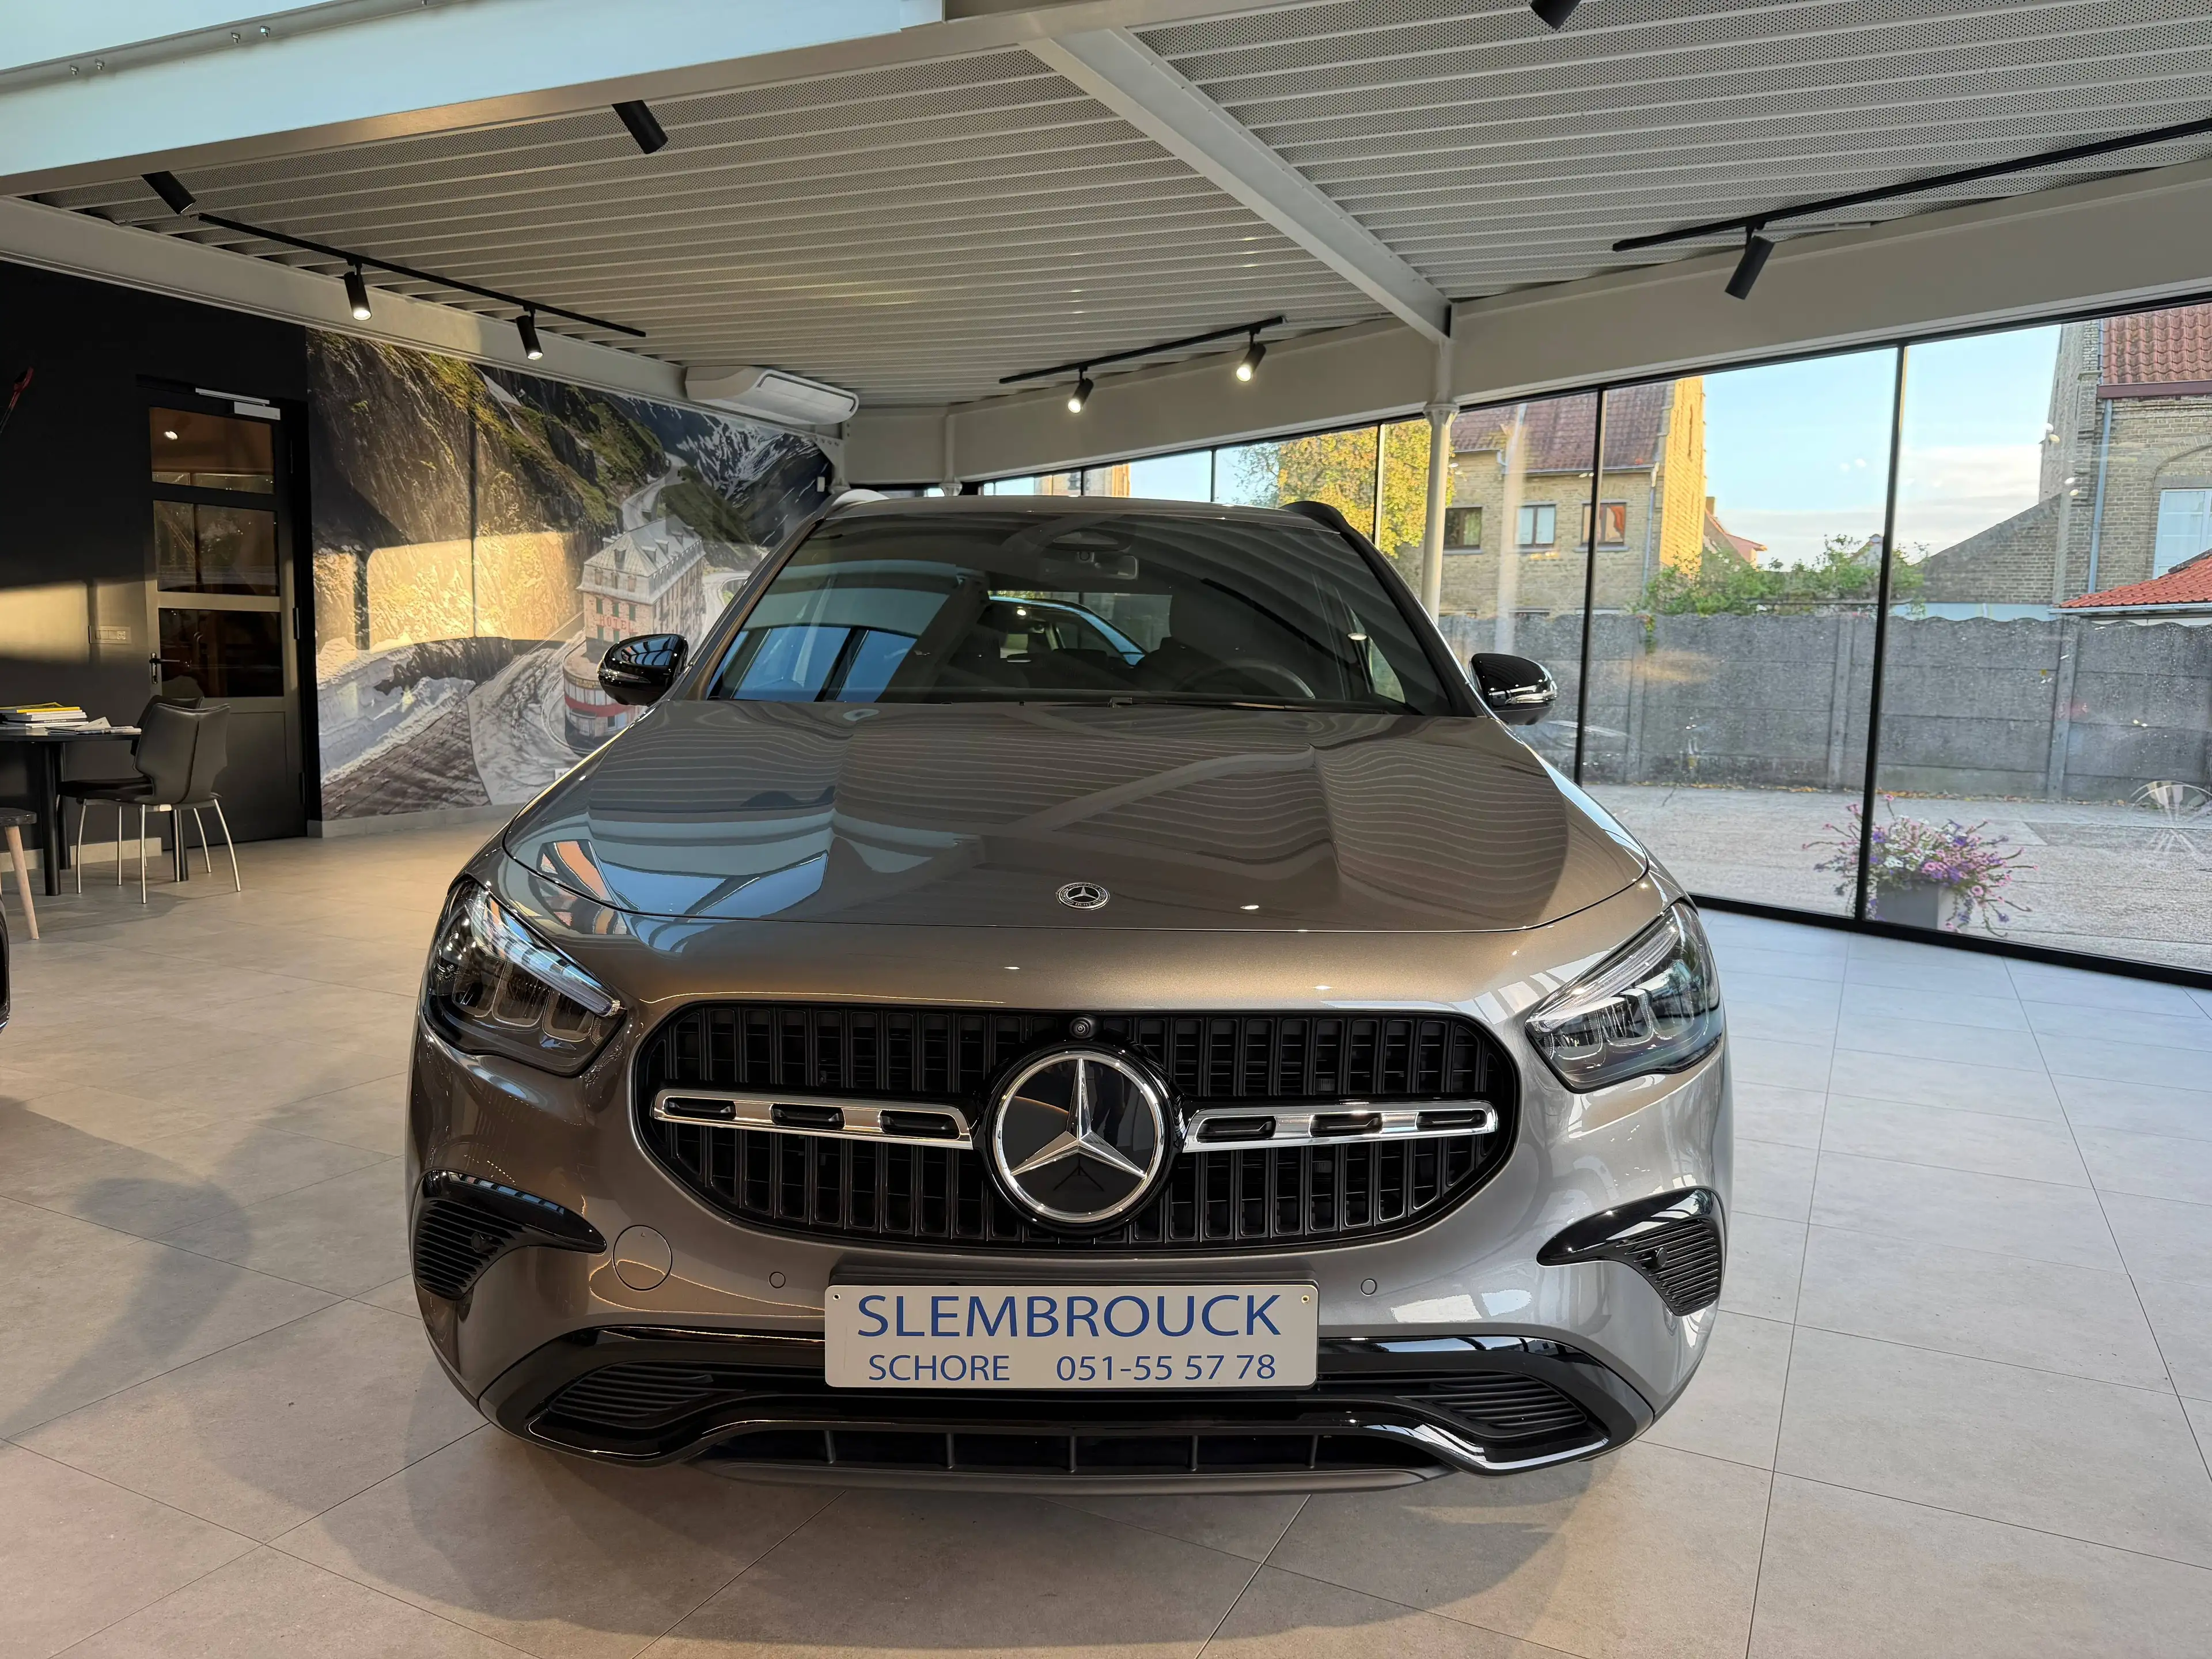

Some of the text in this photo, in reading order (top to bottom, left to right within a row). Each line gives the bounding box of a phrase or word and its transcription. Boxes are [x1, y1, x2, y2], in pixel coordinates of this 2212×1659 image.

[600, 615, 638, 633] HOTEL
[857, 1295, 1282, 1338] SLEMBROUCK
[869, 1354, 1276, 1381] SCHORE 051-55 57 78
